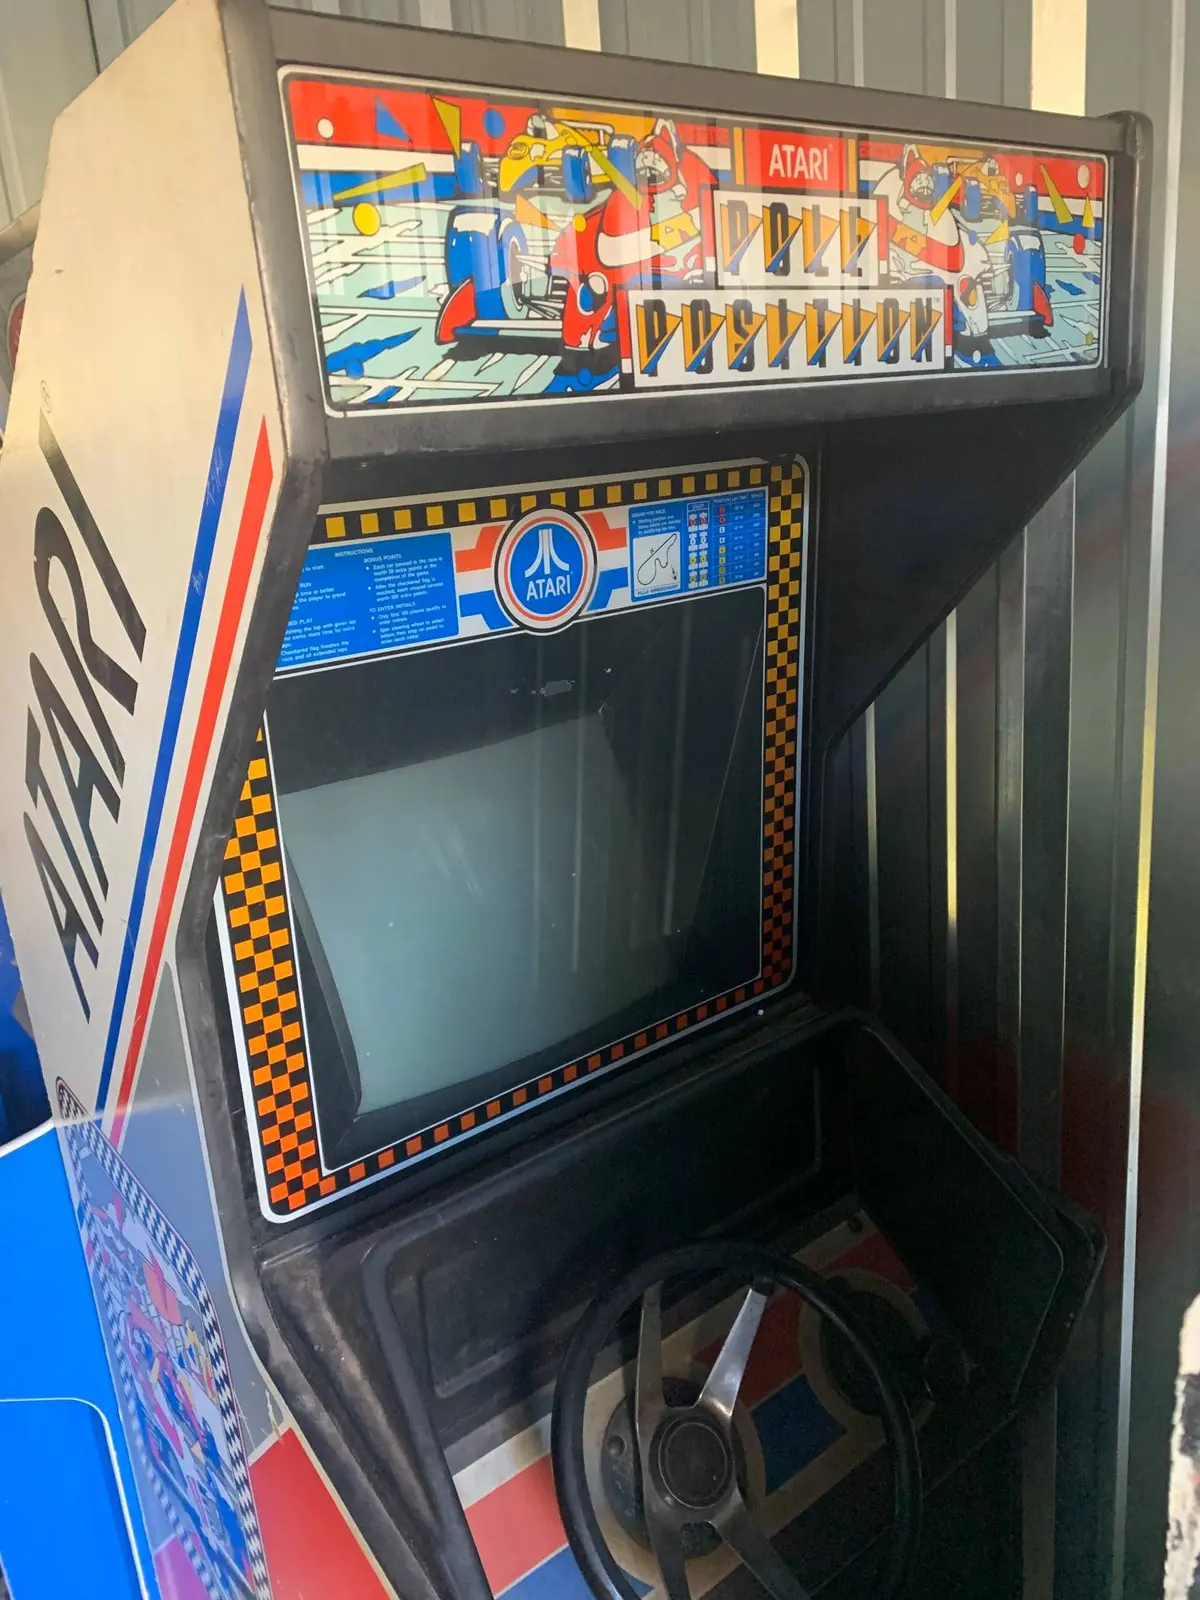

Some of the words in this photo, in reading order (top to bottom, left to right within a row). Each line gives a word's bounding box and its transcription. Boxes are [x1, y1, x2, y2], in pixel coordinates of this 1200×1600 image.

[768, 143, 829, 181] ATARI
[720, 200, 877, 277] POLE
[636, 298, 943, 378] POSITION
[526, 573, 571, 602] ATARI
[23, 407, 147, 1025] ATARI
